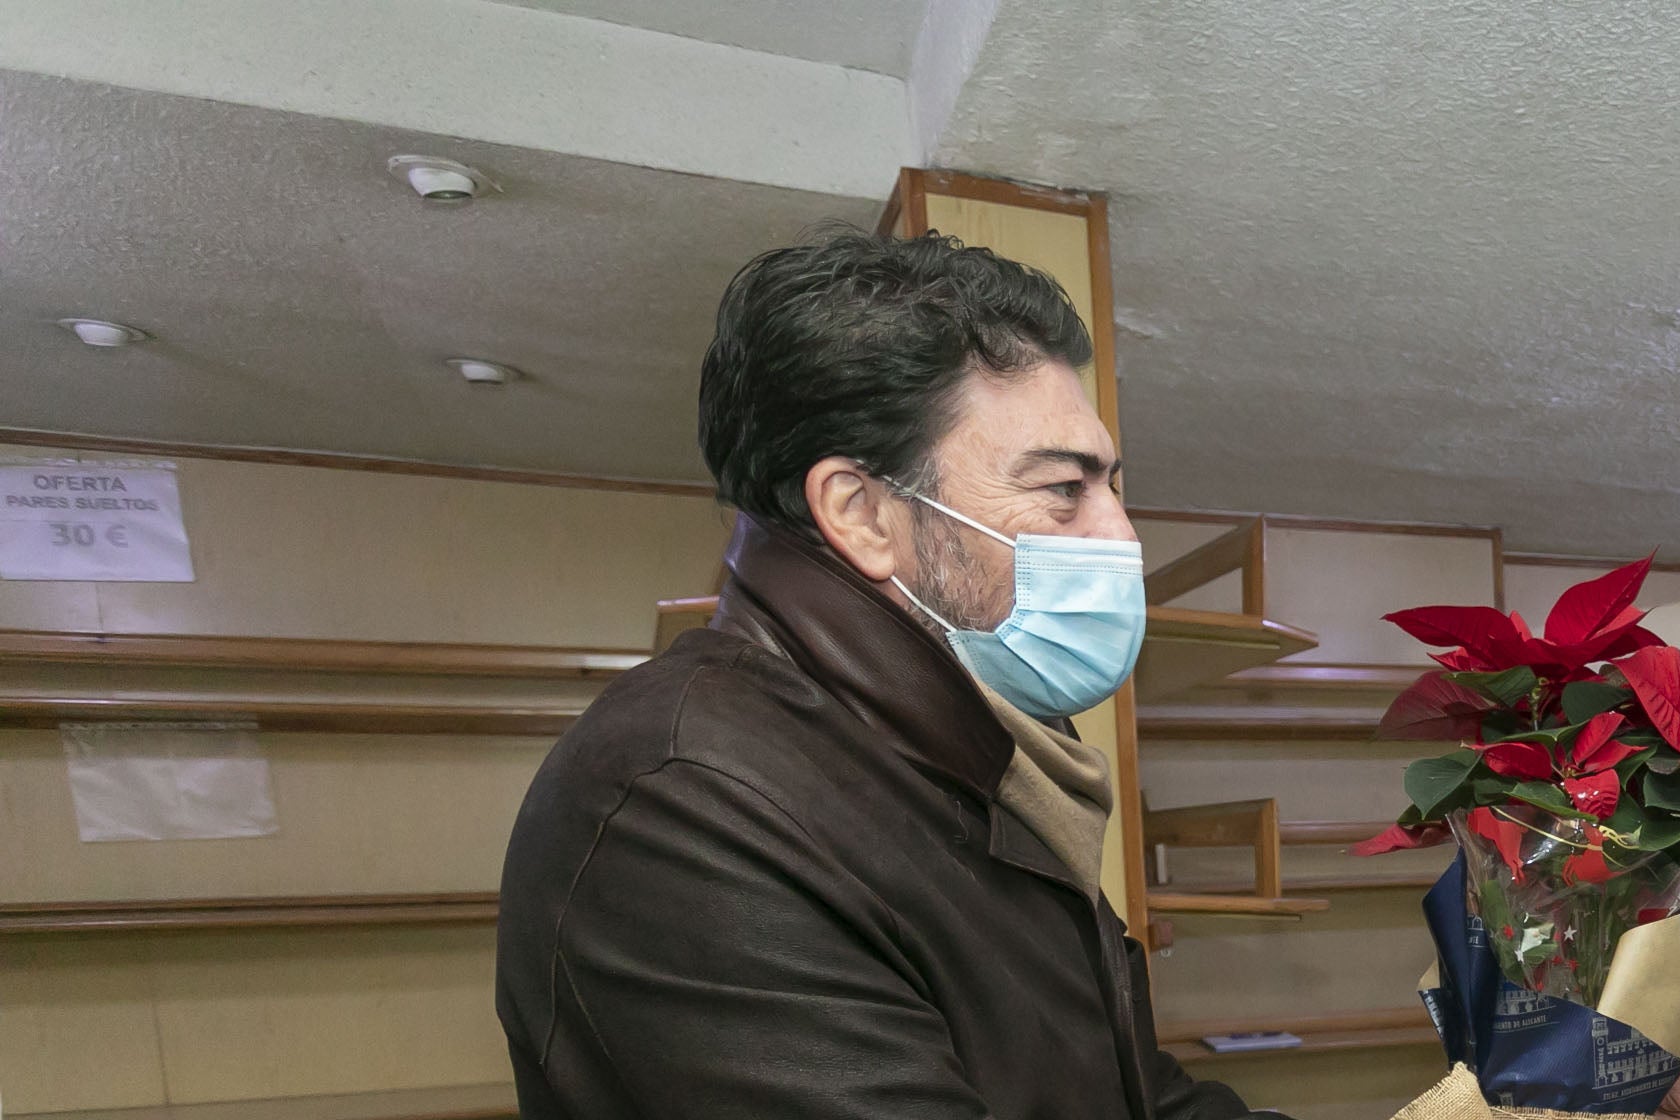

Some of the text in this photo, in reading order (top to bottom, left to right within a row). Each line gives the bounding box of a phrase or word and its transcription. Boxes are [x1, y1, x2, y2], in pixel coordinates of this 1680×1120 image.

[33, 474, 127, 491] OFERTA
[6, 495, 159, 511] PARES SUELTOS
[51, 524, 129, 548] 30 €
